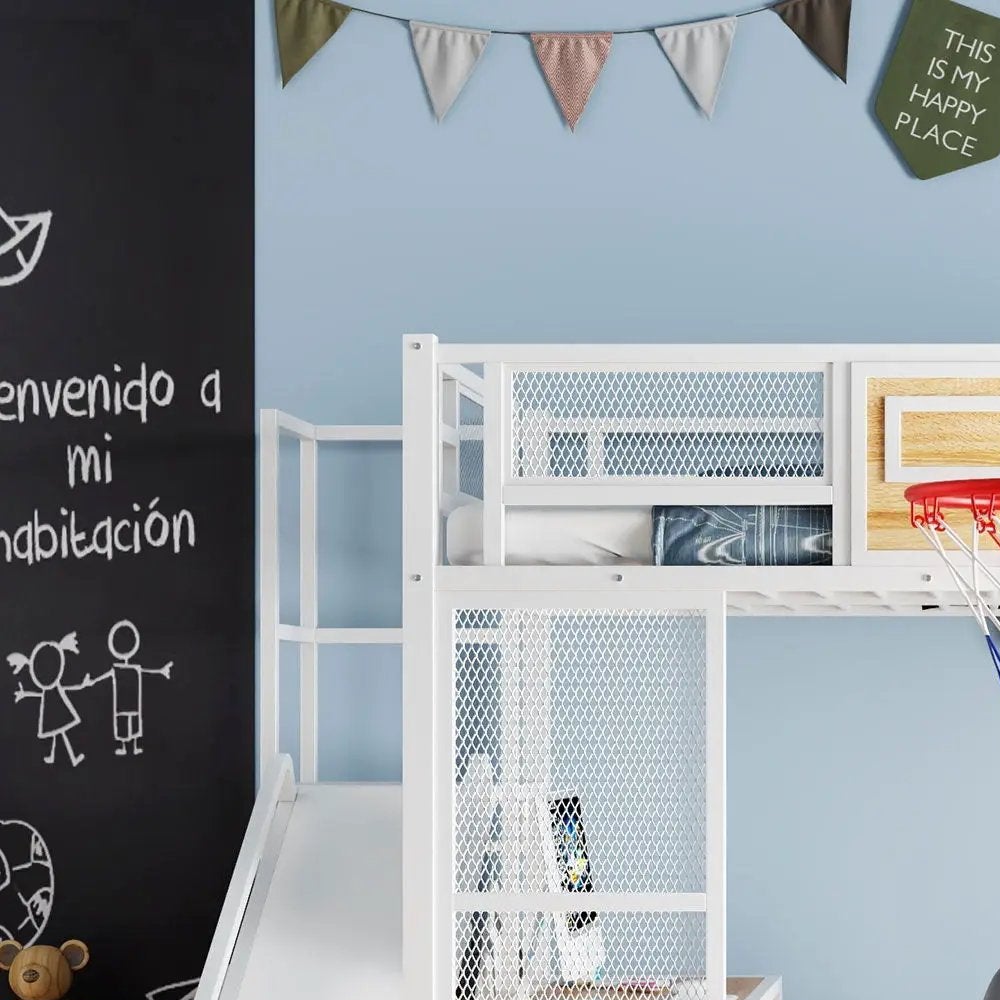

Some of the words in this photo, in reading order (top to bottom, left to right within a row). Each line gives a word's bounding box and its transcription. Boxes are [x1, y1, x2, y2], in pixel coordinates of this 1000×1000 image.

[944, 28, 996, 64] THIS
[927, 56, 949, 80] IS
[950, 65, 990, 93] MY
[909, 83, 987, 125] HAPPY
[894, 111, 978, 157] PLACE
[200, 368, 221, 414] a
[67, 432, 113, 488] mi
